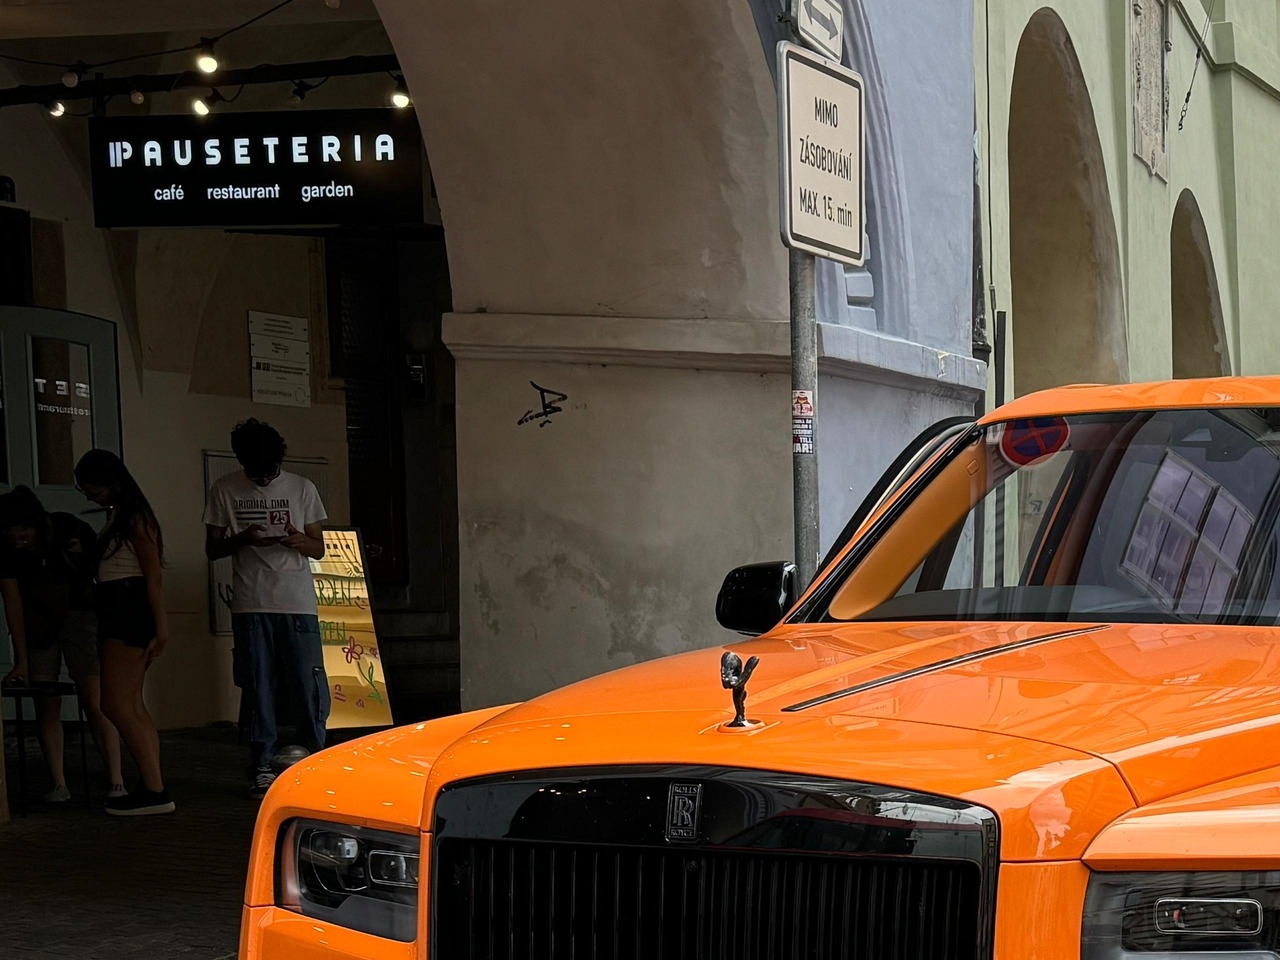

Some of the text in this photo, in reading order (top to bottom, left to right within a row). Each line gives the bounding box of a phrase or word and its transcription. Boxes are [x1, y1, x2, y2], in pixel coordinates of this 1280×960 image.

[814, 96, 839, 128] MIMO
[109, 134, 395, 168] PAUSETERIA
[799, 134, 852, 181] ZÁSOBOVÁNÍ
[154, 181, 353, 202] café restaurant garden
[799, 186, 820, 218] MAX.
[837, 203, 853, 228] min
[273, 511, 288, 525] 25
[674, 786, 698, 794] ROLLS
